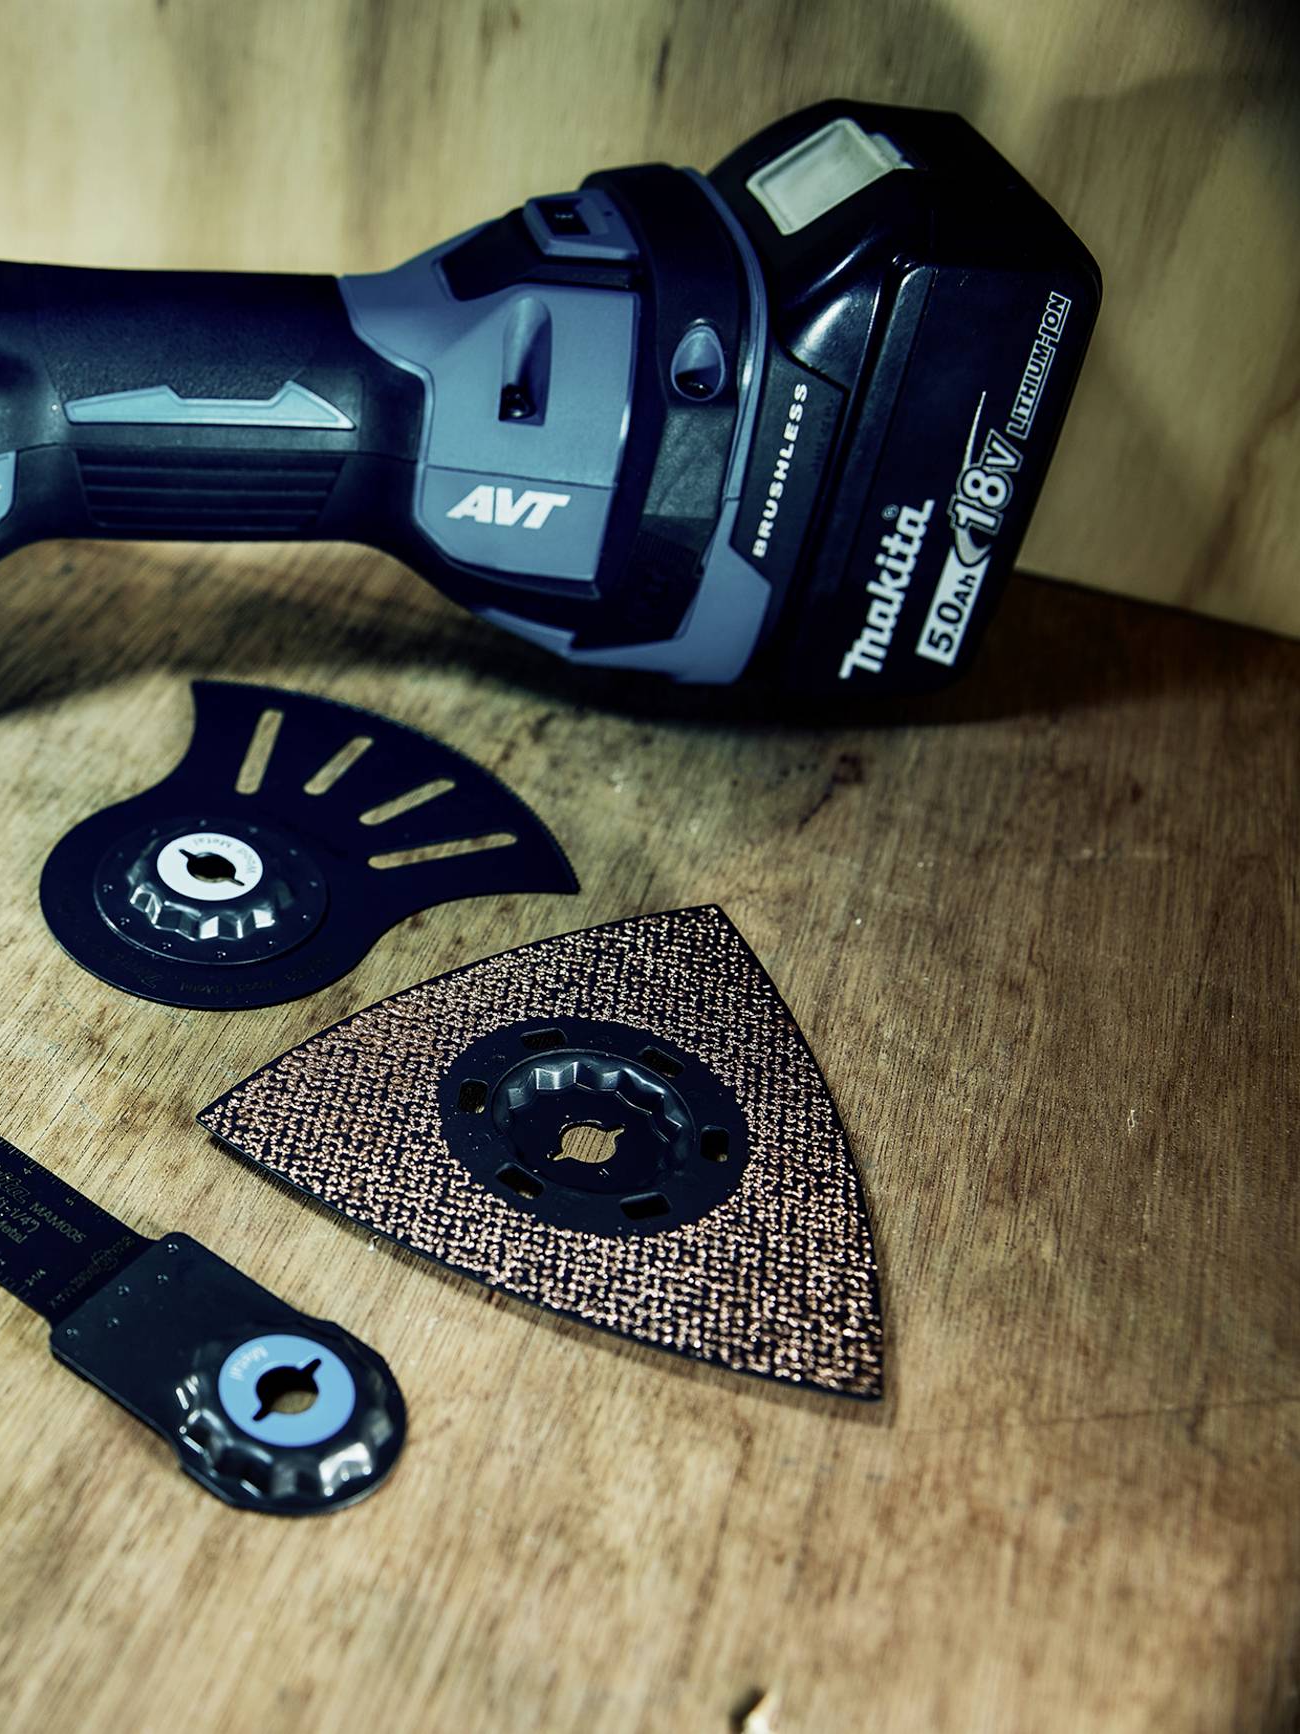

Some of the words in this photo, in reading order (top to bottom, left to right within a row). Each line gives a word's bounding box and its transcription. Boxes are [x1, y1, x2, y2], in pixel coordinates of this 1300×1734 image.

[1006, 291, 1071, 440] LITHIUM-ION
[446, 485, 570, 530] AVT
[752, 383, 808, 557] BRUSHLESS
[952, 434, 1020, 532] 18V
[927, 573, 977, 654] 5.0Ah
